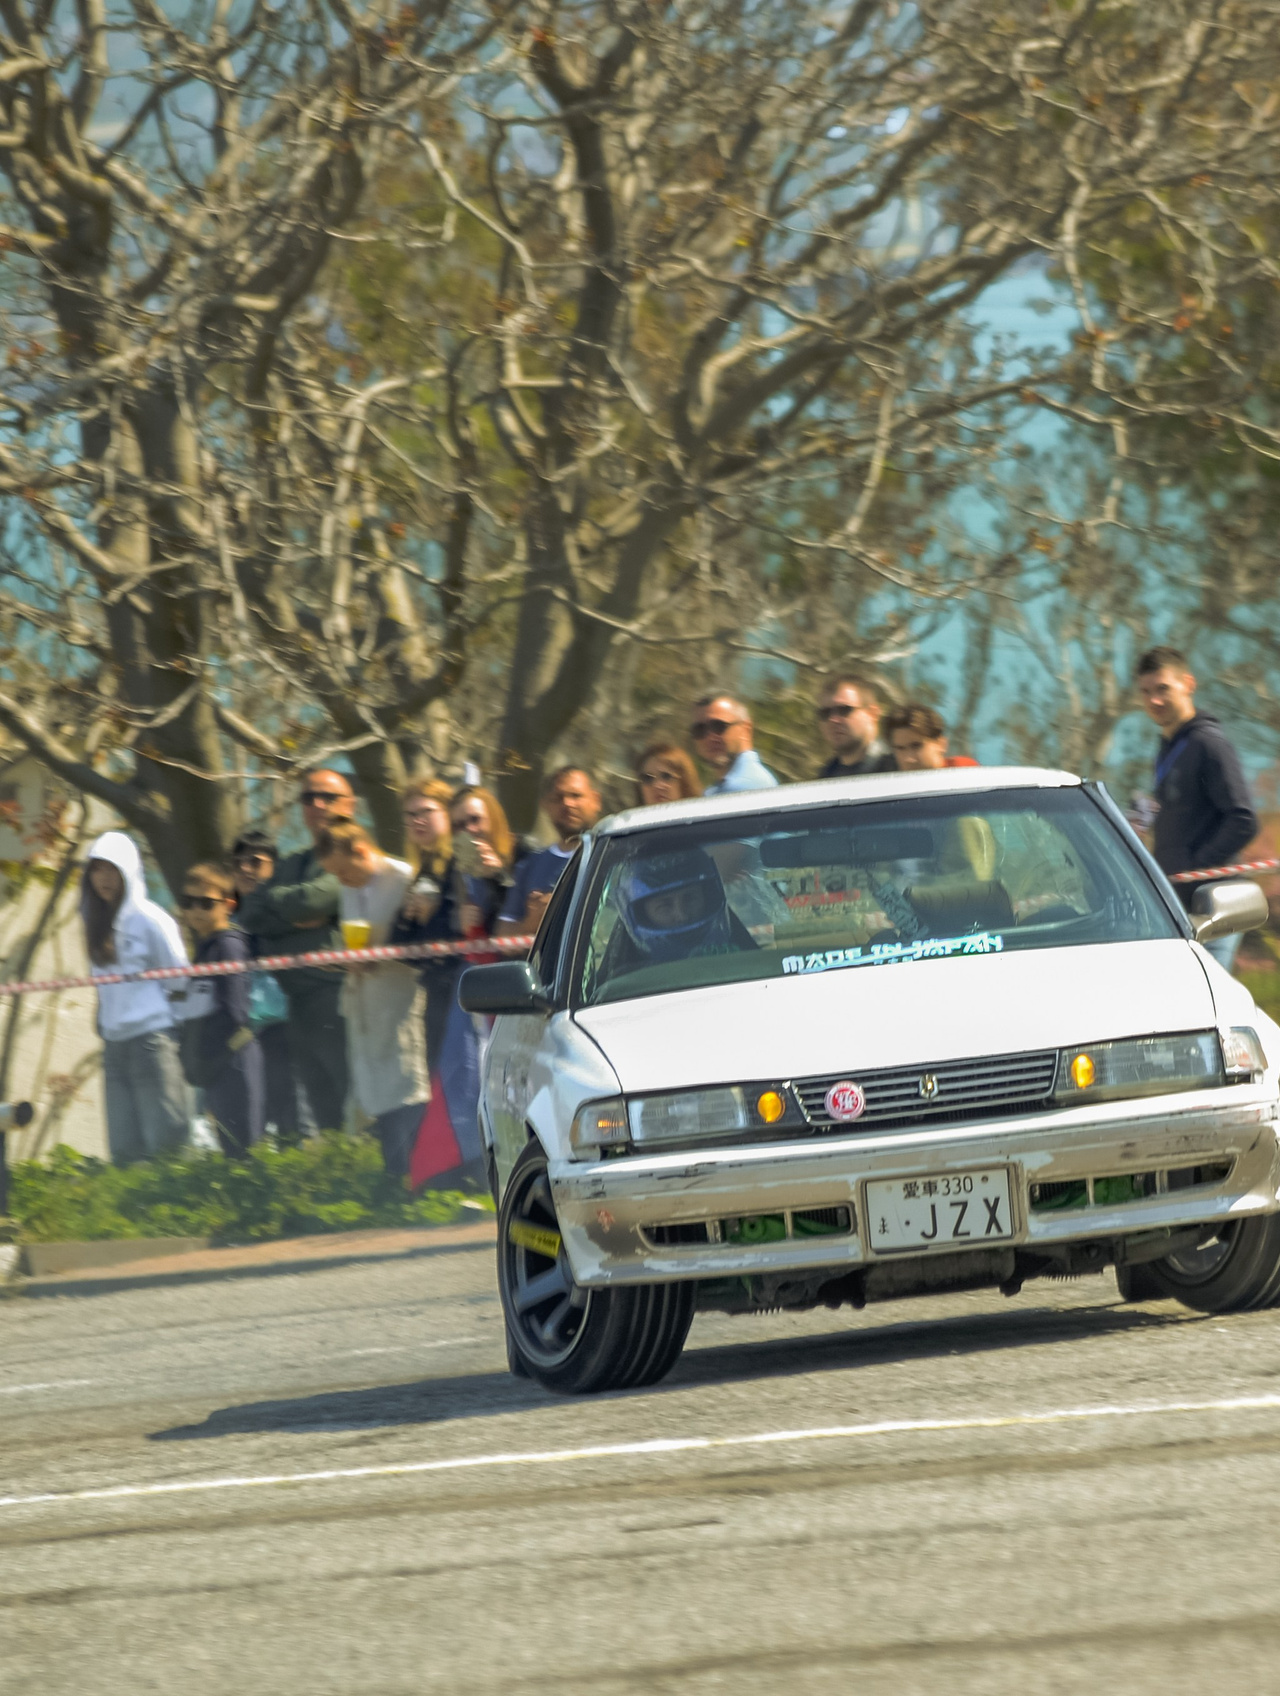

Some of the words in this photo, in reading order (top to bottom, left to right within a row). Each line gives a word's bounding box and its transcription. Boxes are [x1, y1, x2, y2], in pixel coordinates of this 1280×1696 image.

[782, 947, 862, 974] MADE
[871, 942, 902, 960] IN
[912, 932, 1003, 960] JAPAN
